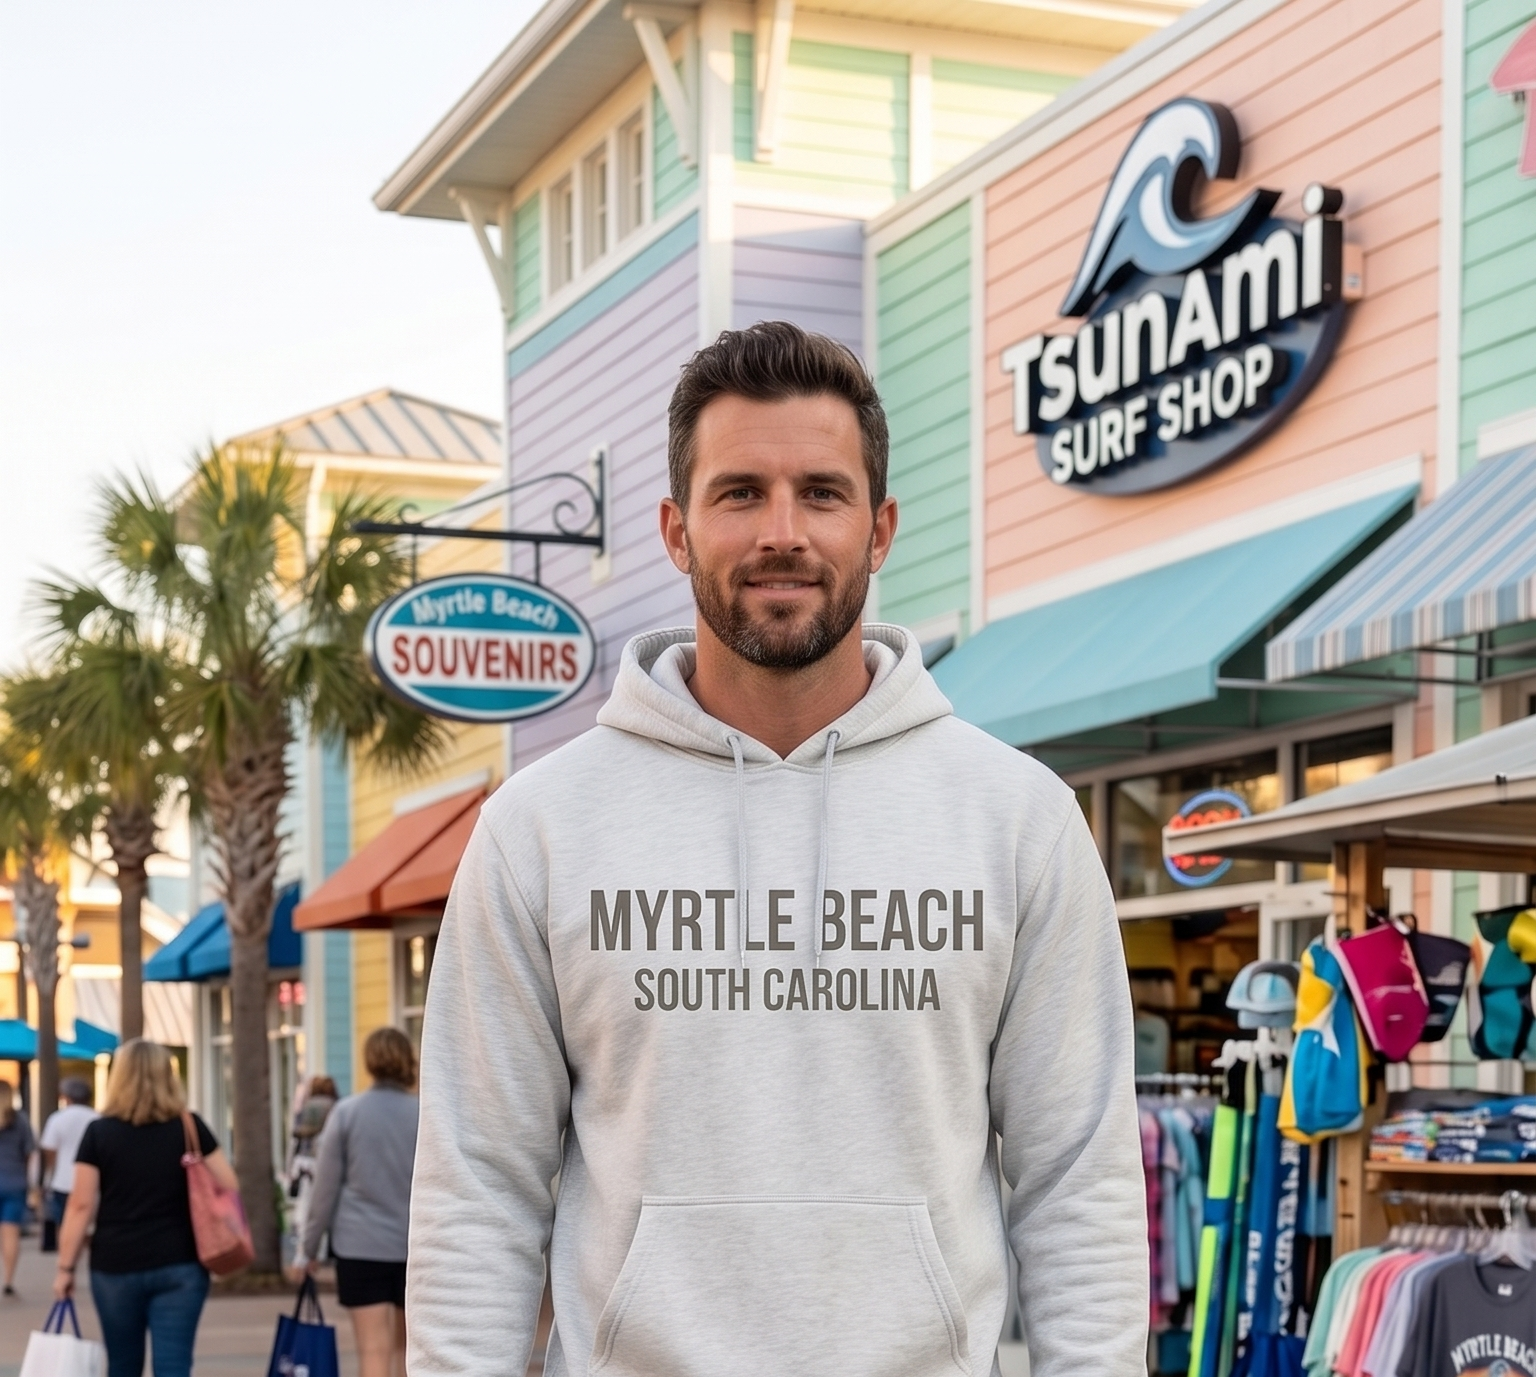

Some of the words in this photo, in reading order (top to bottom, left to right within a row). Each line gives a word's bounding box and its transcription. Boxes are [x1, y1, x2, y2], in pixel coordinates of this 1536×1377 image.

[1051, 395, 1148, 485] SURF
[1157, 344, 1274, 442] SHOP
[411, 587, 486, 625] Myrtle
[492, 589, 559, 631] Beach
[393, 634, 578, 682] SOUVENIRS
[590, 889, 795, 951] MYRTLE
[822, 889, 984, 951] BEACH
[634, 968, 750, 1011] SOUTH
[763, 968, 941, 1011] CAROLINA
